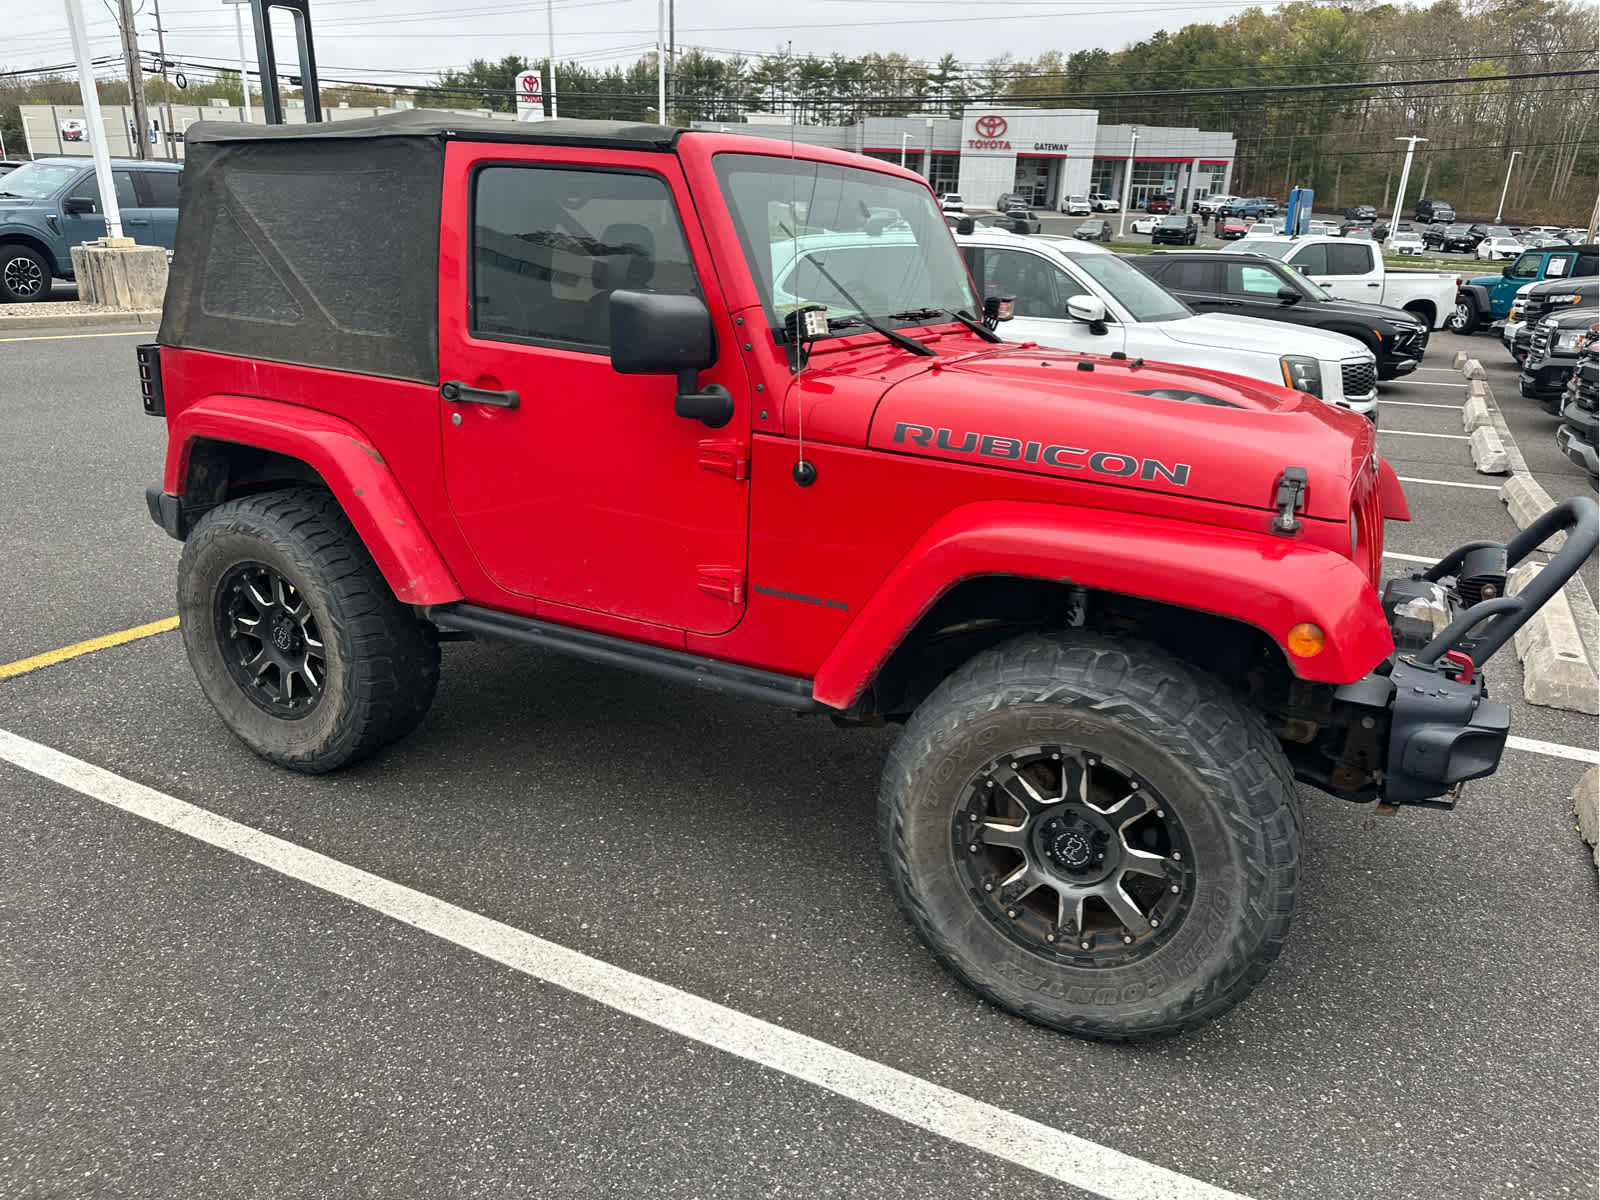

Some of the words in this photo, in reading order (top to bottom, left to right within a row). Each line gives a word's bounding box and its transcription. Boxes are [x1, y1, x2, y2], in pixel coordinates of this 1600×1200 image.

[968, 140, 1011, 149] TOYOTA
[1034, 143, 1068, 151] GATEWAY
[893, 422, 1191, 487] RUBICON
[753, 584, 849, 612] WRANGLER
